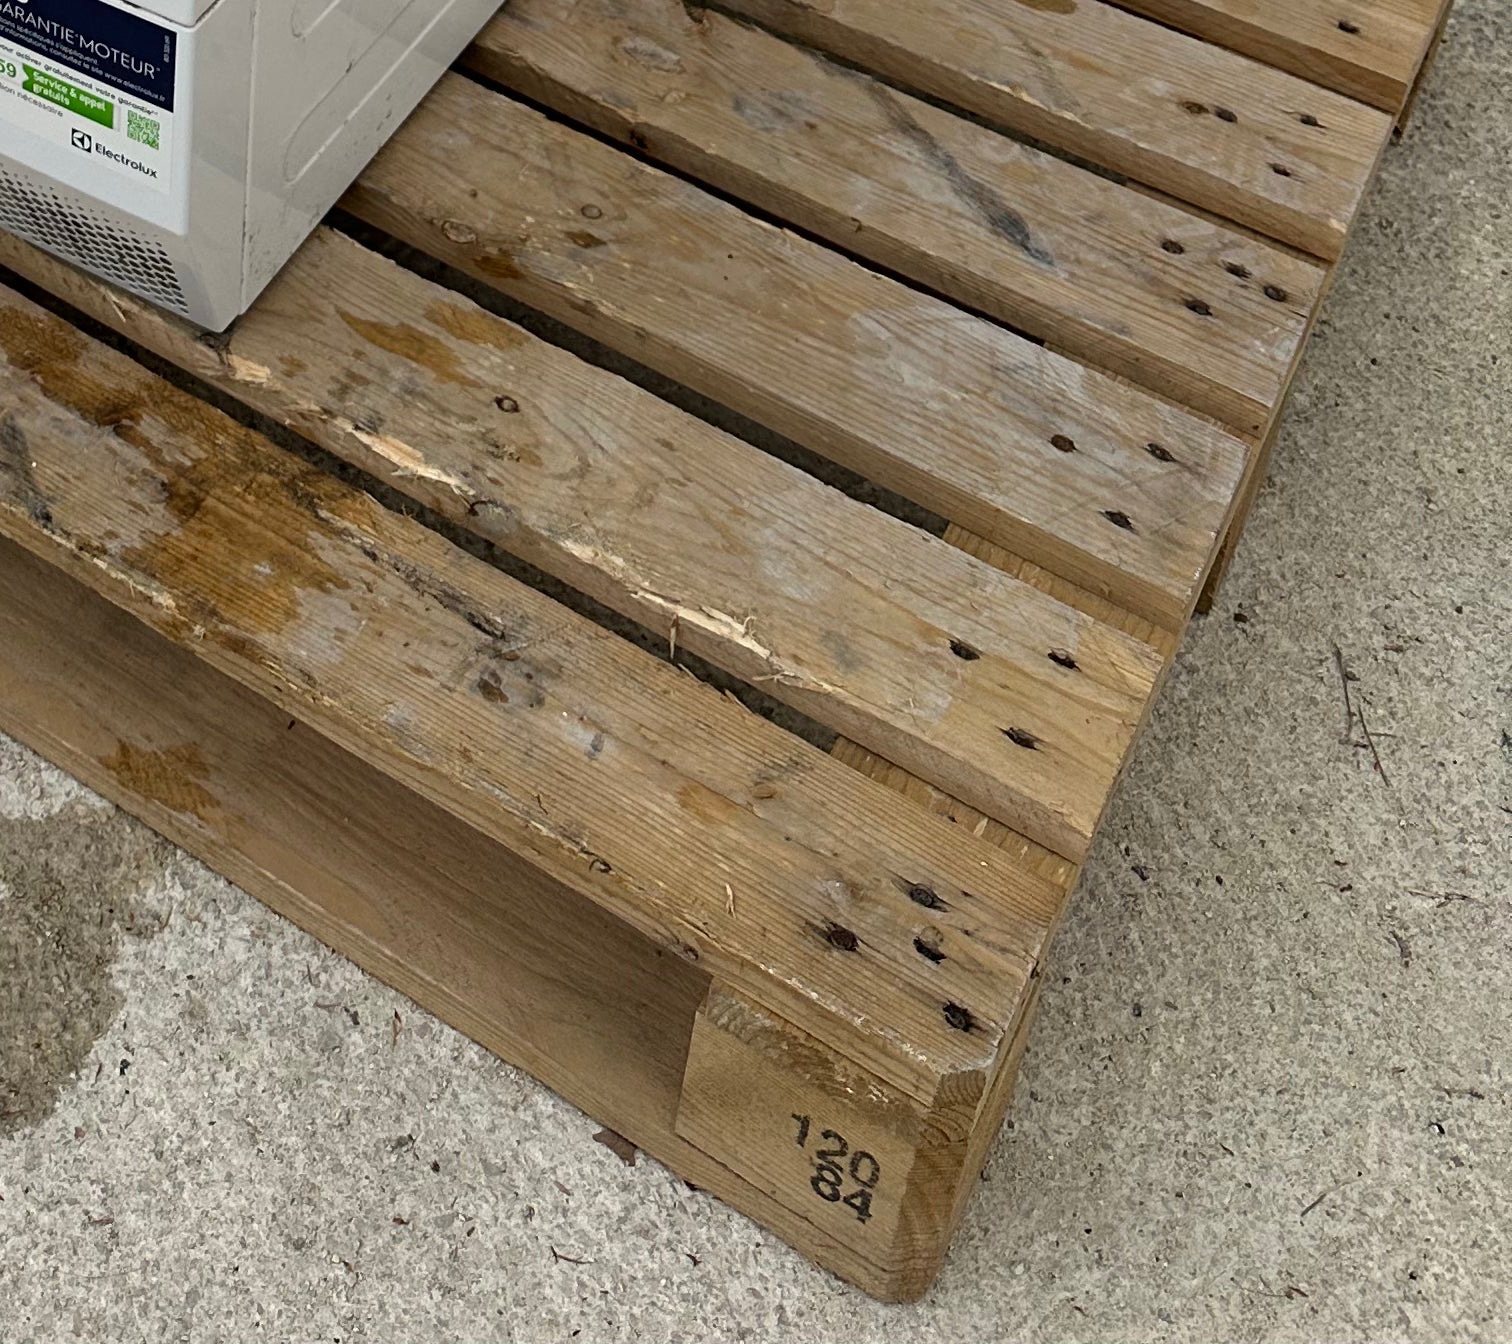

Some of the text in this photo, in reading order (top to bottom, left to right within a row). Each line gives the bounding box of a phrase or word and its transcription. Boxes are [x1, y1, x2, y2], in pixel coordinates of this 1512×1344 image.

[32, 70, 105, 114] Service & appel
[32, 79, 69, 105] gratuits
[95, 142, 157, 178] Electrolux
[792, 1112, 880, 1190] 120
